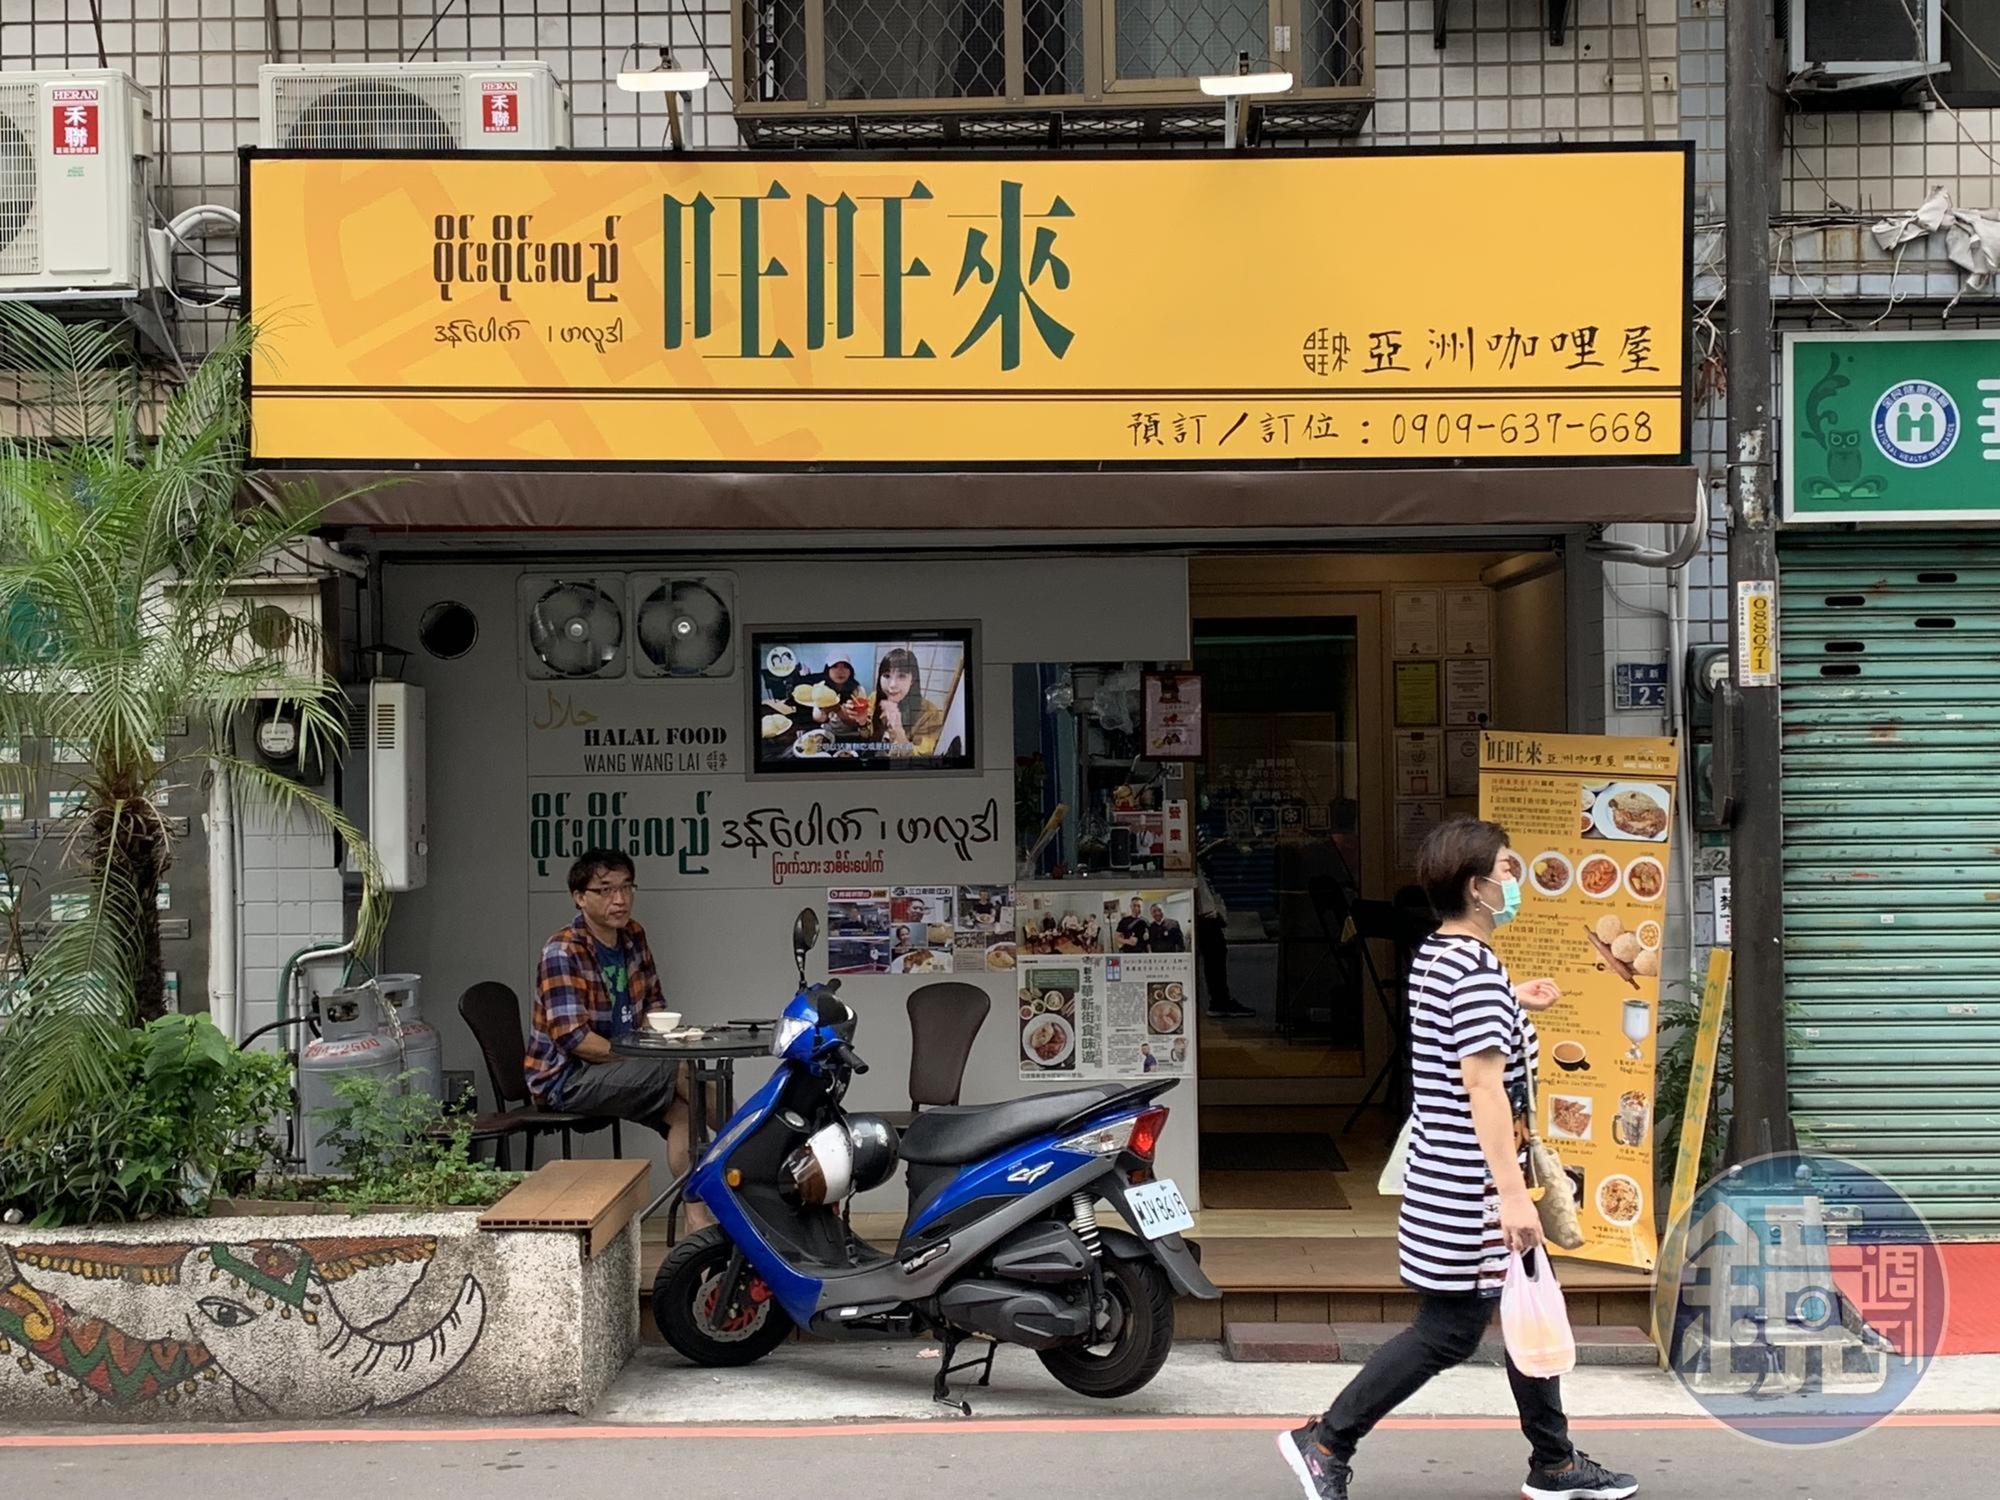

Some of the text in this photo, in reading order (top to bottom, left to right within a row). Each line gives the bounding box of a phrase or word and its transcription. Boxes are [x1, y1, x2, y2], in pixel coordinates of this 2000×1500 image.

[54, 90, 97, 100] HERAN
[491, 95, 509, 127] 禾聯
[64, 106, 88, 147] 禾聯
[663, 178, 1077, 372] 旺旺來
[1361, 326, 1661, 373] 亞洲咖哩屋
[1391, 411, 1654, 446] 0909-637-668
[1876, 423, 1898, 457] NATIONAL
[533, 688, 599, 730] حلال
[583, 727, 727, 747] HALAL FOOD
[1487, 740, 1542, 766] 旺旺來
[583, 753, 626, 773] WANG
[631, 752, 673, 772] WANG
[678, 752, 700, 771] LAI
